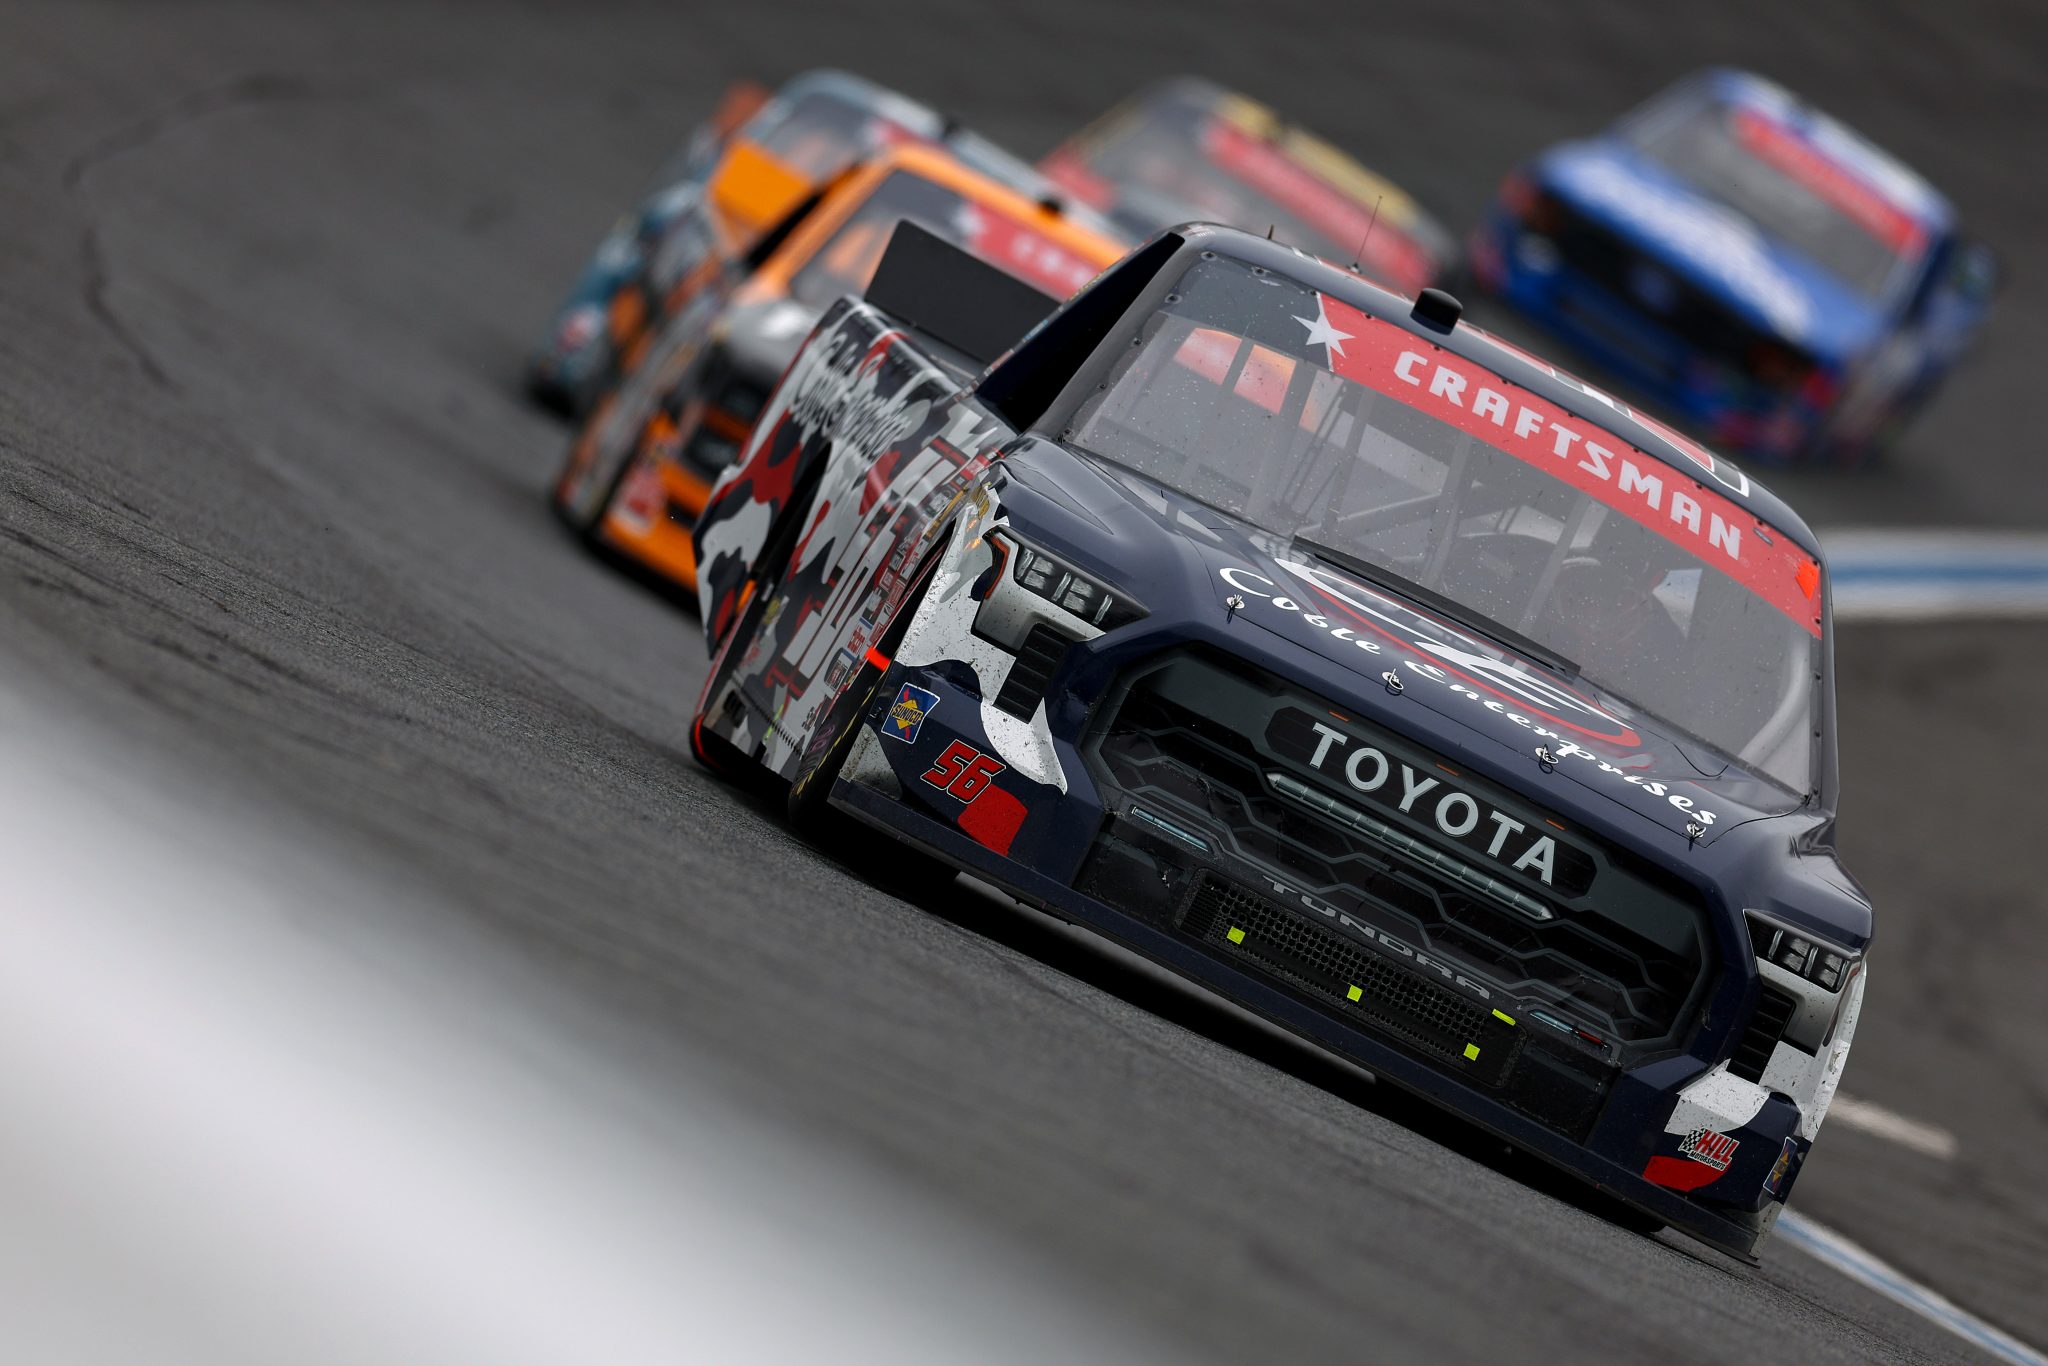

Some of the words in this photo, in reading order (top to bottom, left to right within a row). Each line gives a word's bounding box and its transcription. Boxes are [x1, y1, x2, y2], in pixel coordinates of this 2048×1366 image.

[1393, 350, 1741, 561] CRAFTSMAN
[893, 704, 923, 724] SUNOCO
[1219, 566, 1381, 656] Coble
[1404, 659, 1717, 827] Enterprises
[920, 739, 1006, 804] 56
[1308, 721, 1556, 887] TOYOTA
[1261, 875, 1490, 1000] TUNDRA
[1690, 1150, 1726, 1171] MOTORSPORTS
[1693, 1129, 1739, 1164] HILL
